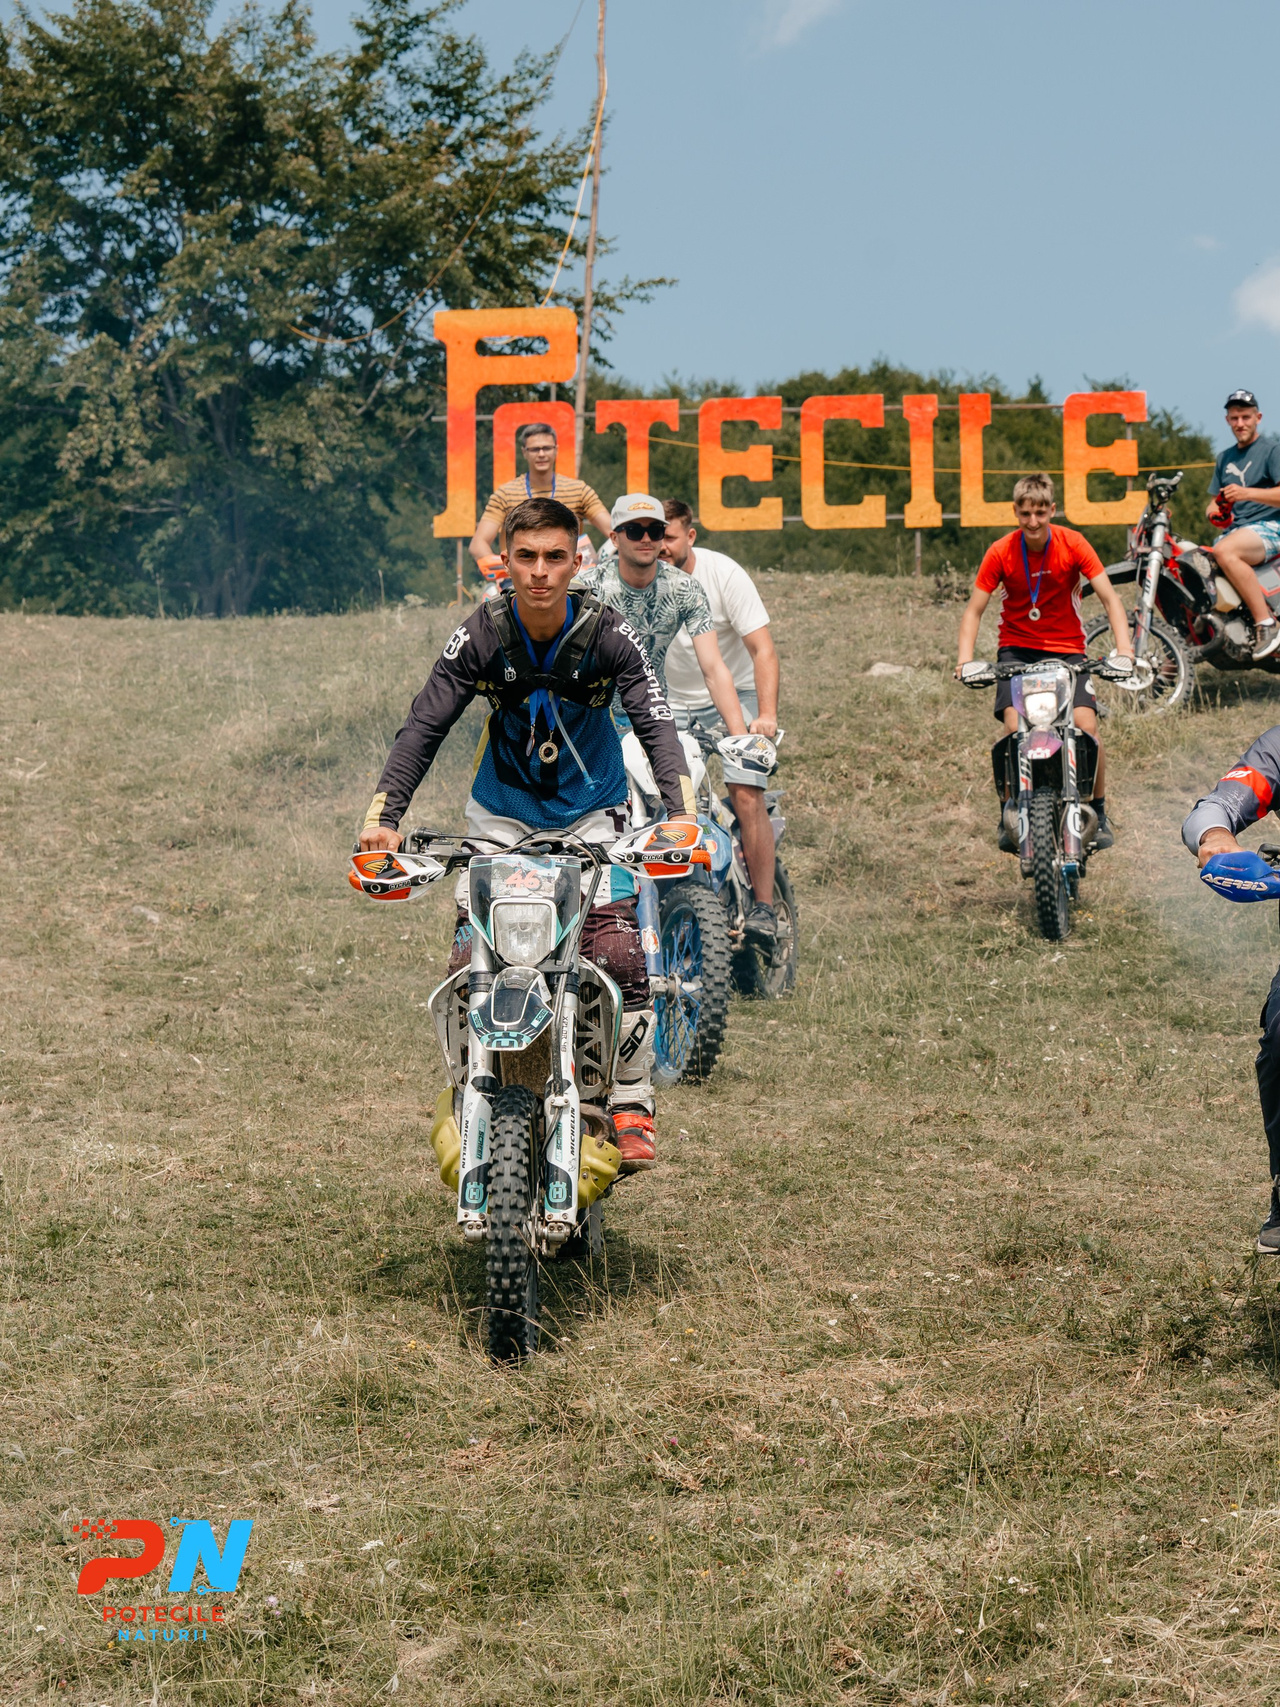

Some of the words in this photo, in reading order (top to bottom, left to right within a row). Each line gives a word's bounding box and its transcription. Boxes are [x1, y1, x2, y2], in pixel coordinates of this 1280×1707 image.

[506, 868, 541, 889] 46
[1201, 873, 1268, 892] ACERBIS
[461, 1120, 469, 1169] MICHELIN
